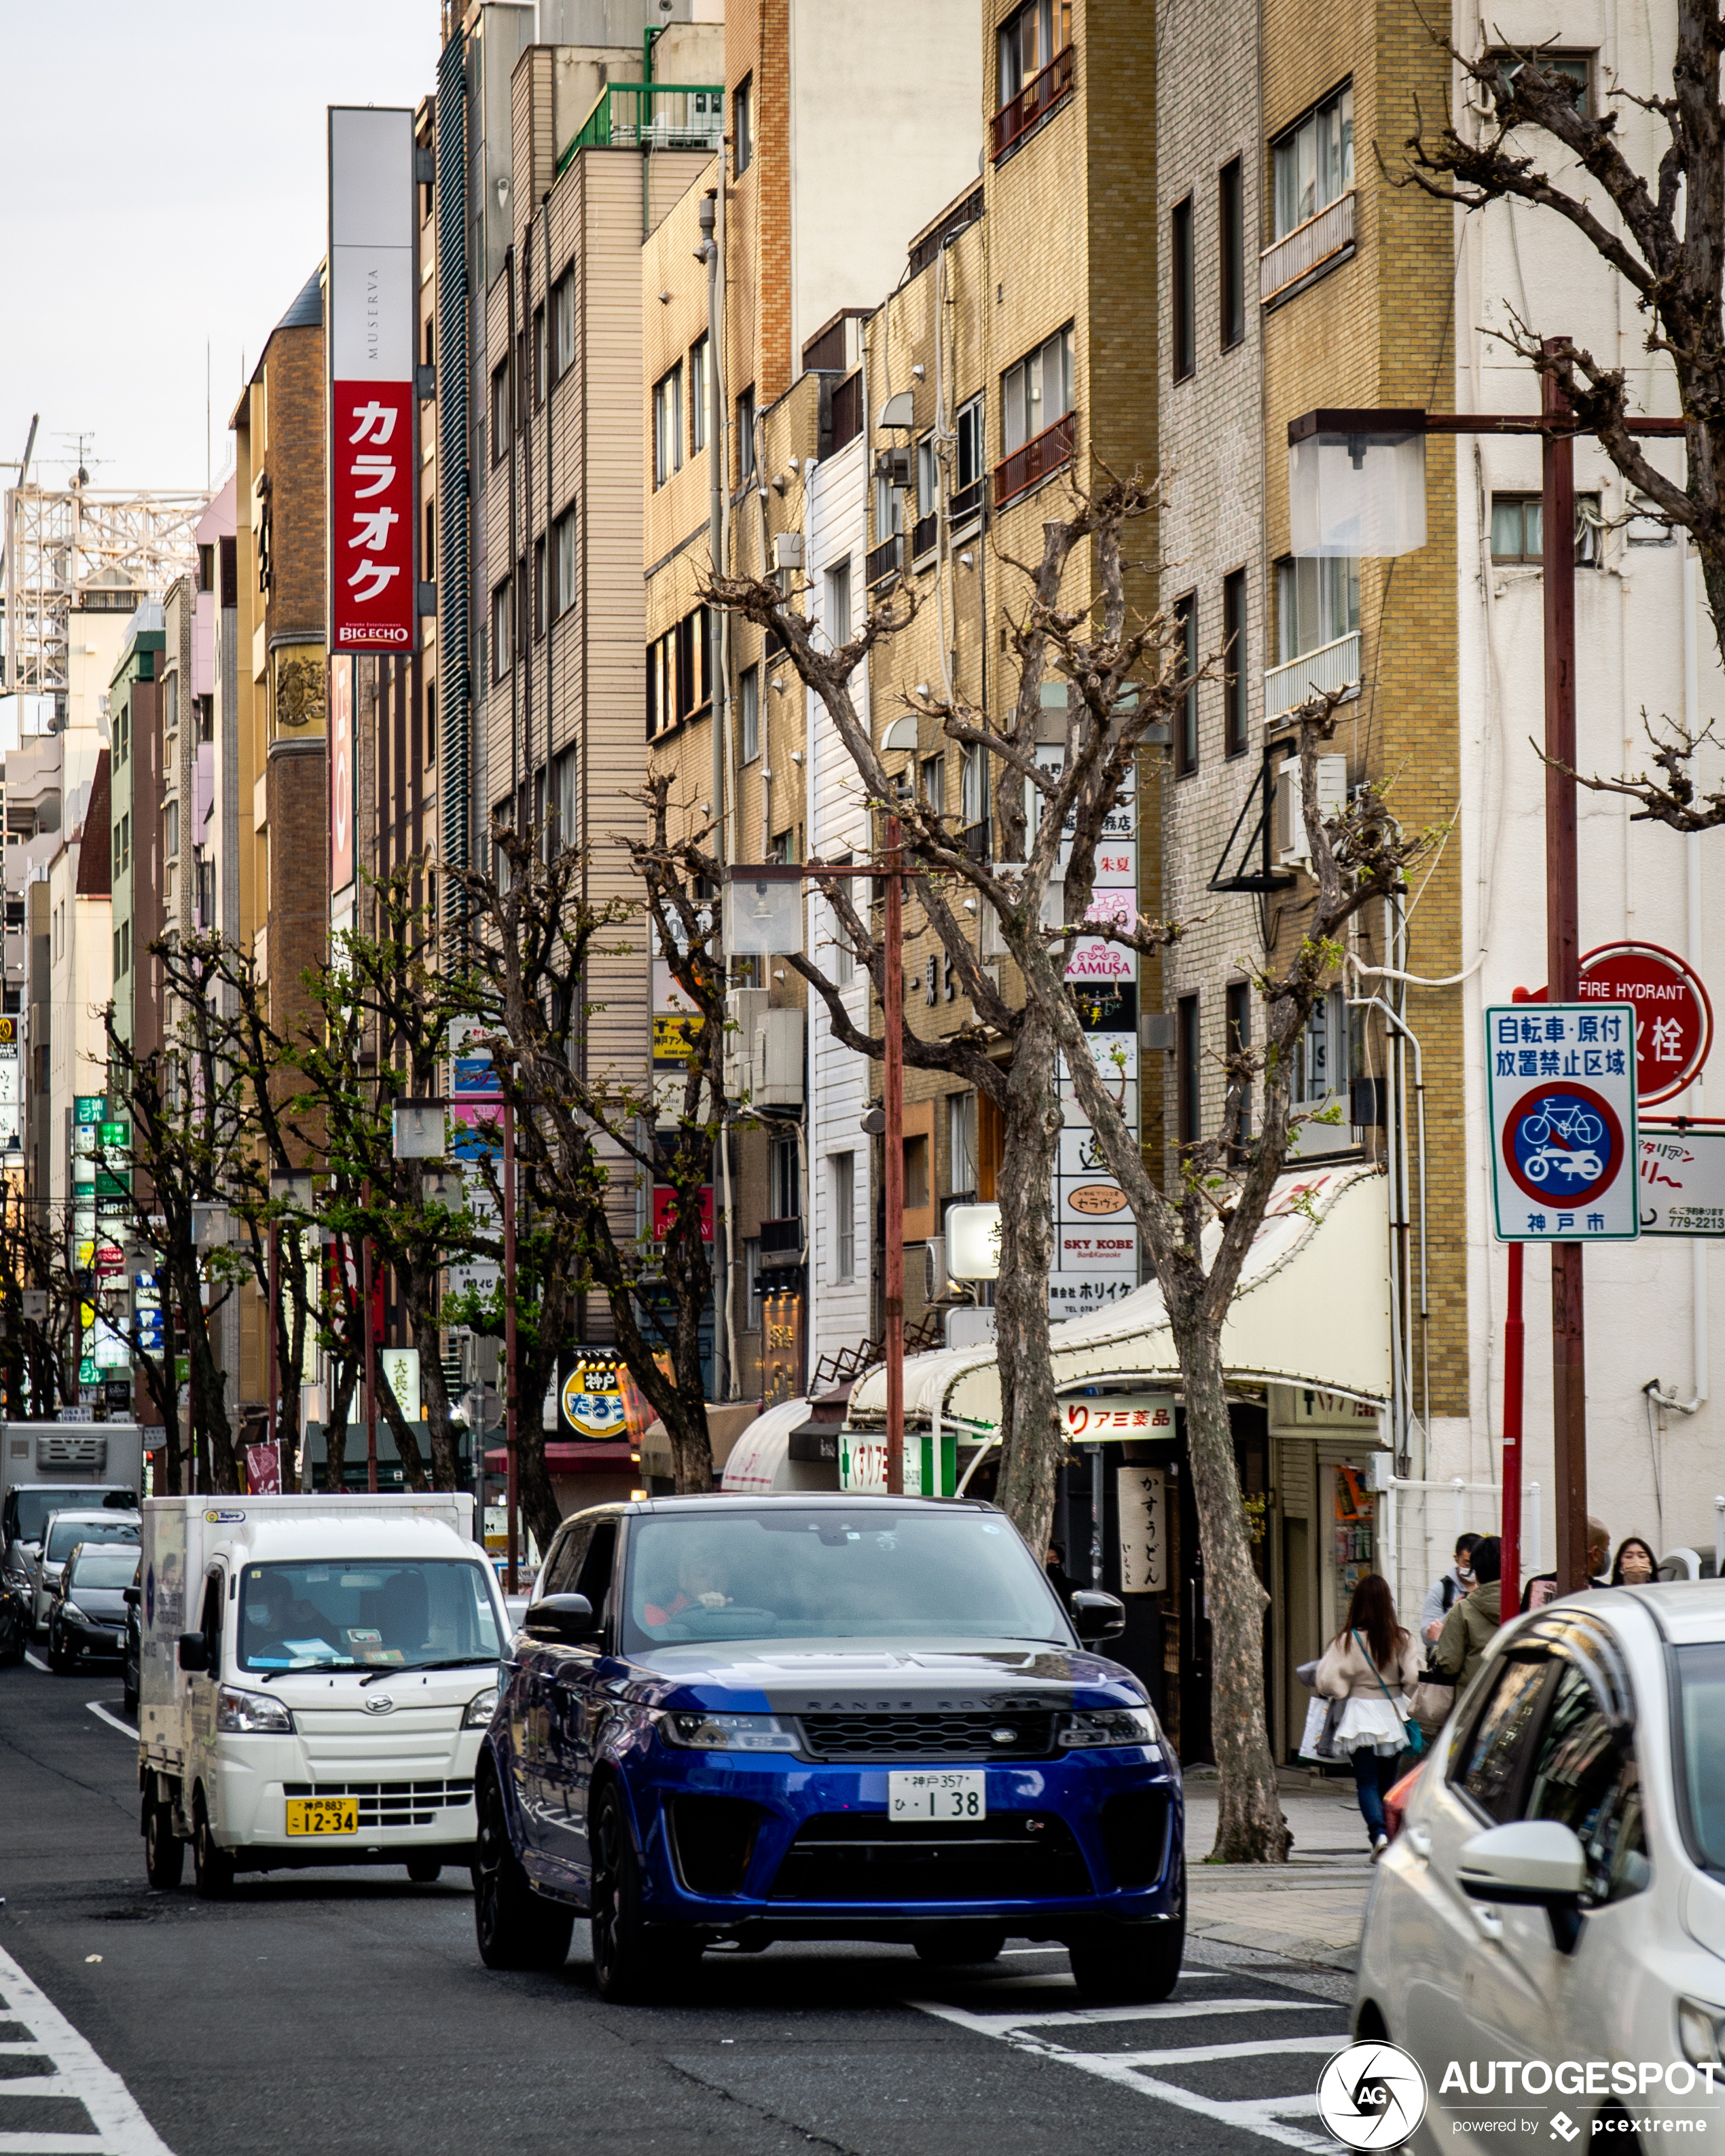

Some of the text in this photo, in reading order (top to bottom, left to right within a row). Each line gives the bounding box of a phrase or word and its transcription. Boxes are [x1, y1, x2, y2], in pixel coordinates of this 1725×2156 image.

[367, 270, 378, 360] MUSERVA
[347, 401, 400, 603] カラオケ
[340, 627, 408, 642] BIG ECHO
[1100, 856, 1130, 872] 朱夏
[1066, 962, 1131, 974] KAMUSA
[1578, 981, 1686, 1000] FIRE HYDRANT
[1496, 1048, 1626, 1077] 放置禁止区域
[1669, 1216, 1725, 1229] 779-2213
[1064, 1240, 1133, 1249] SKY KOBE
[1079, 1282, 1132, 1300] ホリイケ
[585, 1372, 615, 1391] 神戸
[1140, 1476, 1160, 1585] かすうどん
[807, 1699, 1041, 1711] RANGE ROVER
[305, 1812, 354, 1832] 12-34
